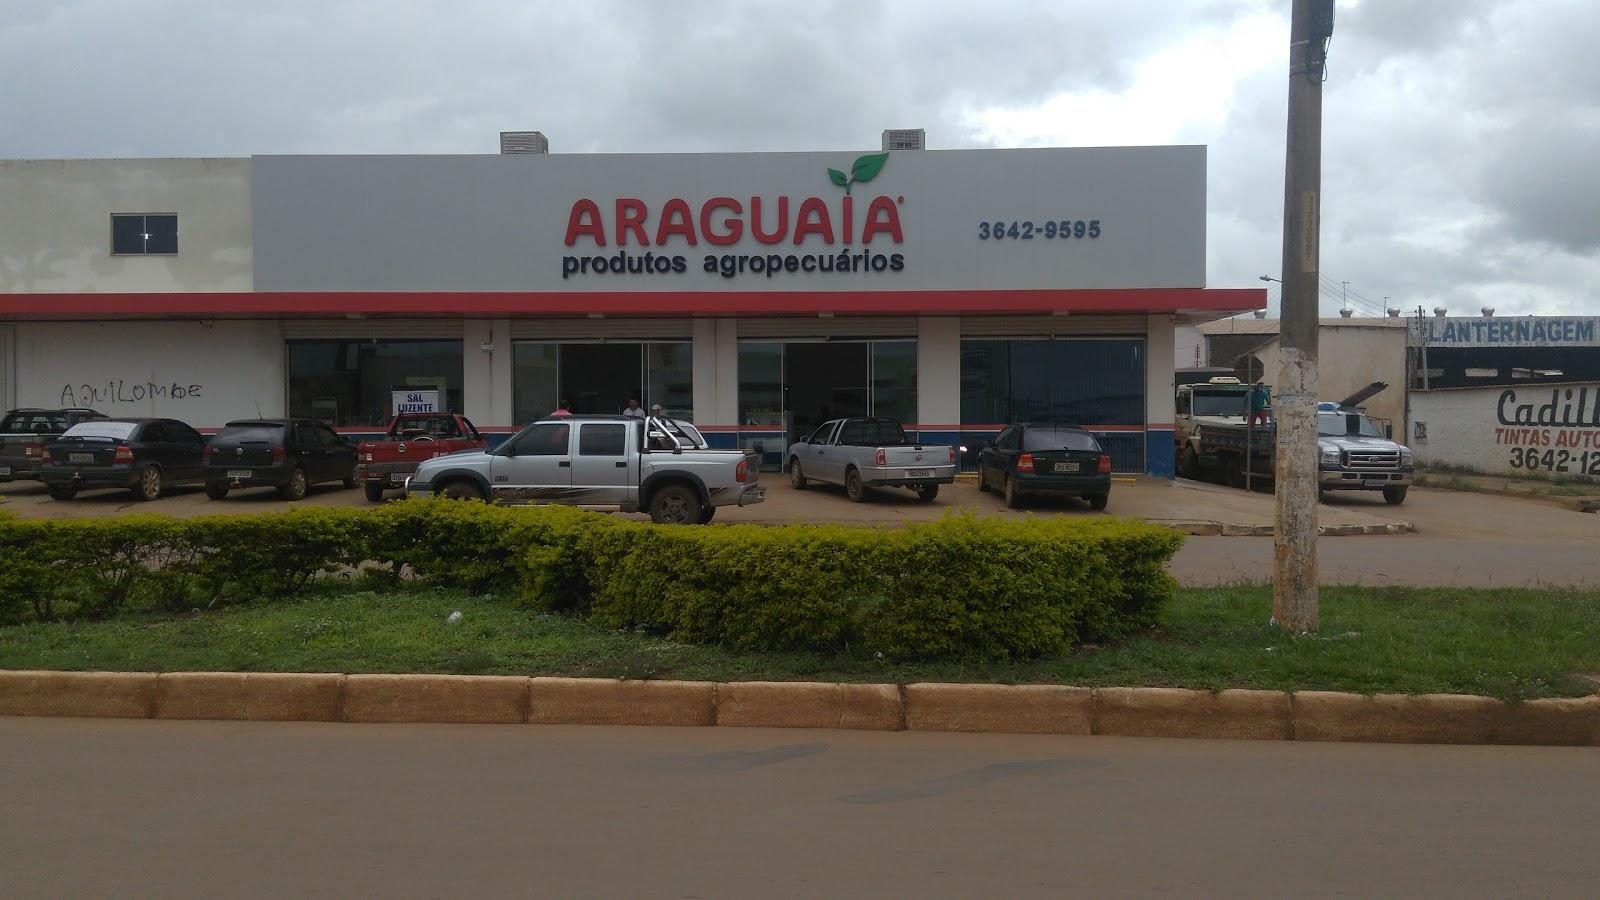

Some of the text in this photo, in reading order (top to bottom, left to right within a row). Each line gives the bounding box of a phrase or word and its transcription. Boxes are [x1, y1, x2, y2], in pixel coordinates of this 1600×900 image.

[564, 195, 904, 246] ARAGUAIA
[979, 220, 1101, 240] 3642-9595
[562, 248, 904, 278] produtos agropecuários
[1427, 320, 1594, 342] LANTERNAGEM
[397, 403, 433, 412] LUZENTE
[407, 393, 424, 402] SAL
[1495, 428, 1550, 447] TINTAS
